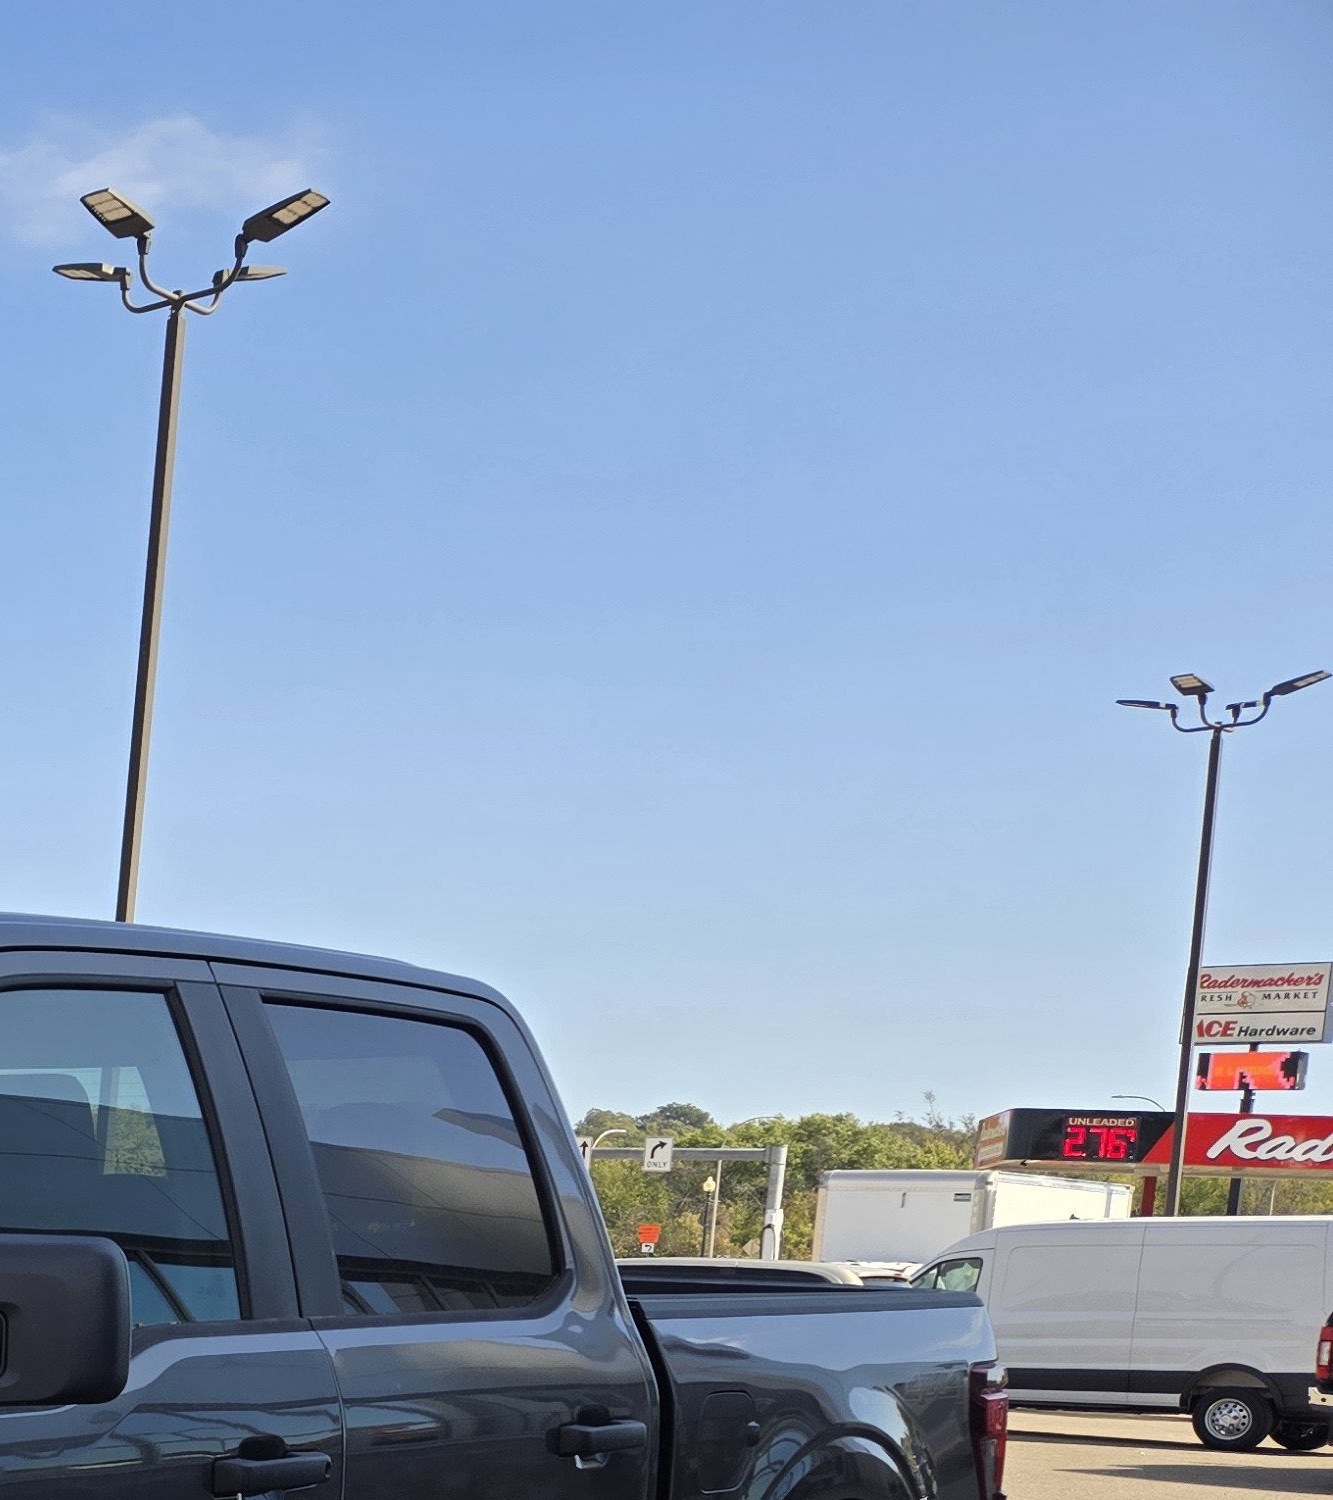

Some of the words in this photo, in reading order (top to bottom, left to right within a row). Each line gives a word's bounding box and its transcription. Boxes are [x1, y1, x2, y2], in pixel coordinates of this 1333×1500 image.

[1200, 994, 1233, 1002] RESH
[1261, 991, 1319, 1000] MARKET
[1237, 1025, 1316, 1037] Hardware
[1068, 1117, 1135, 1127] UNLEADED
[646, 1161, 668, 1169] ONLY
